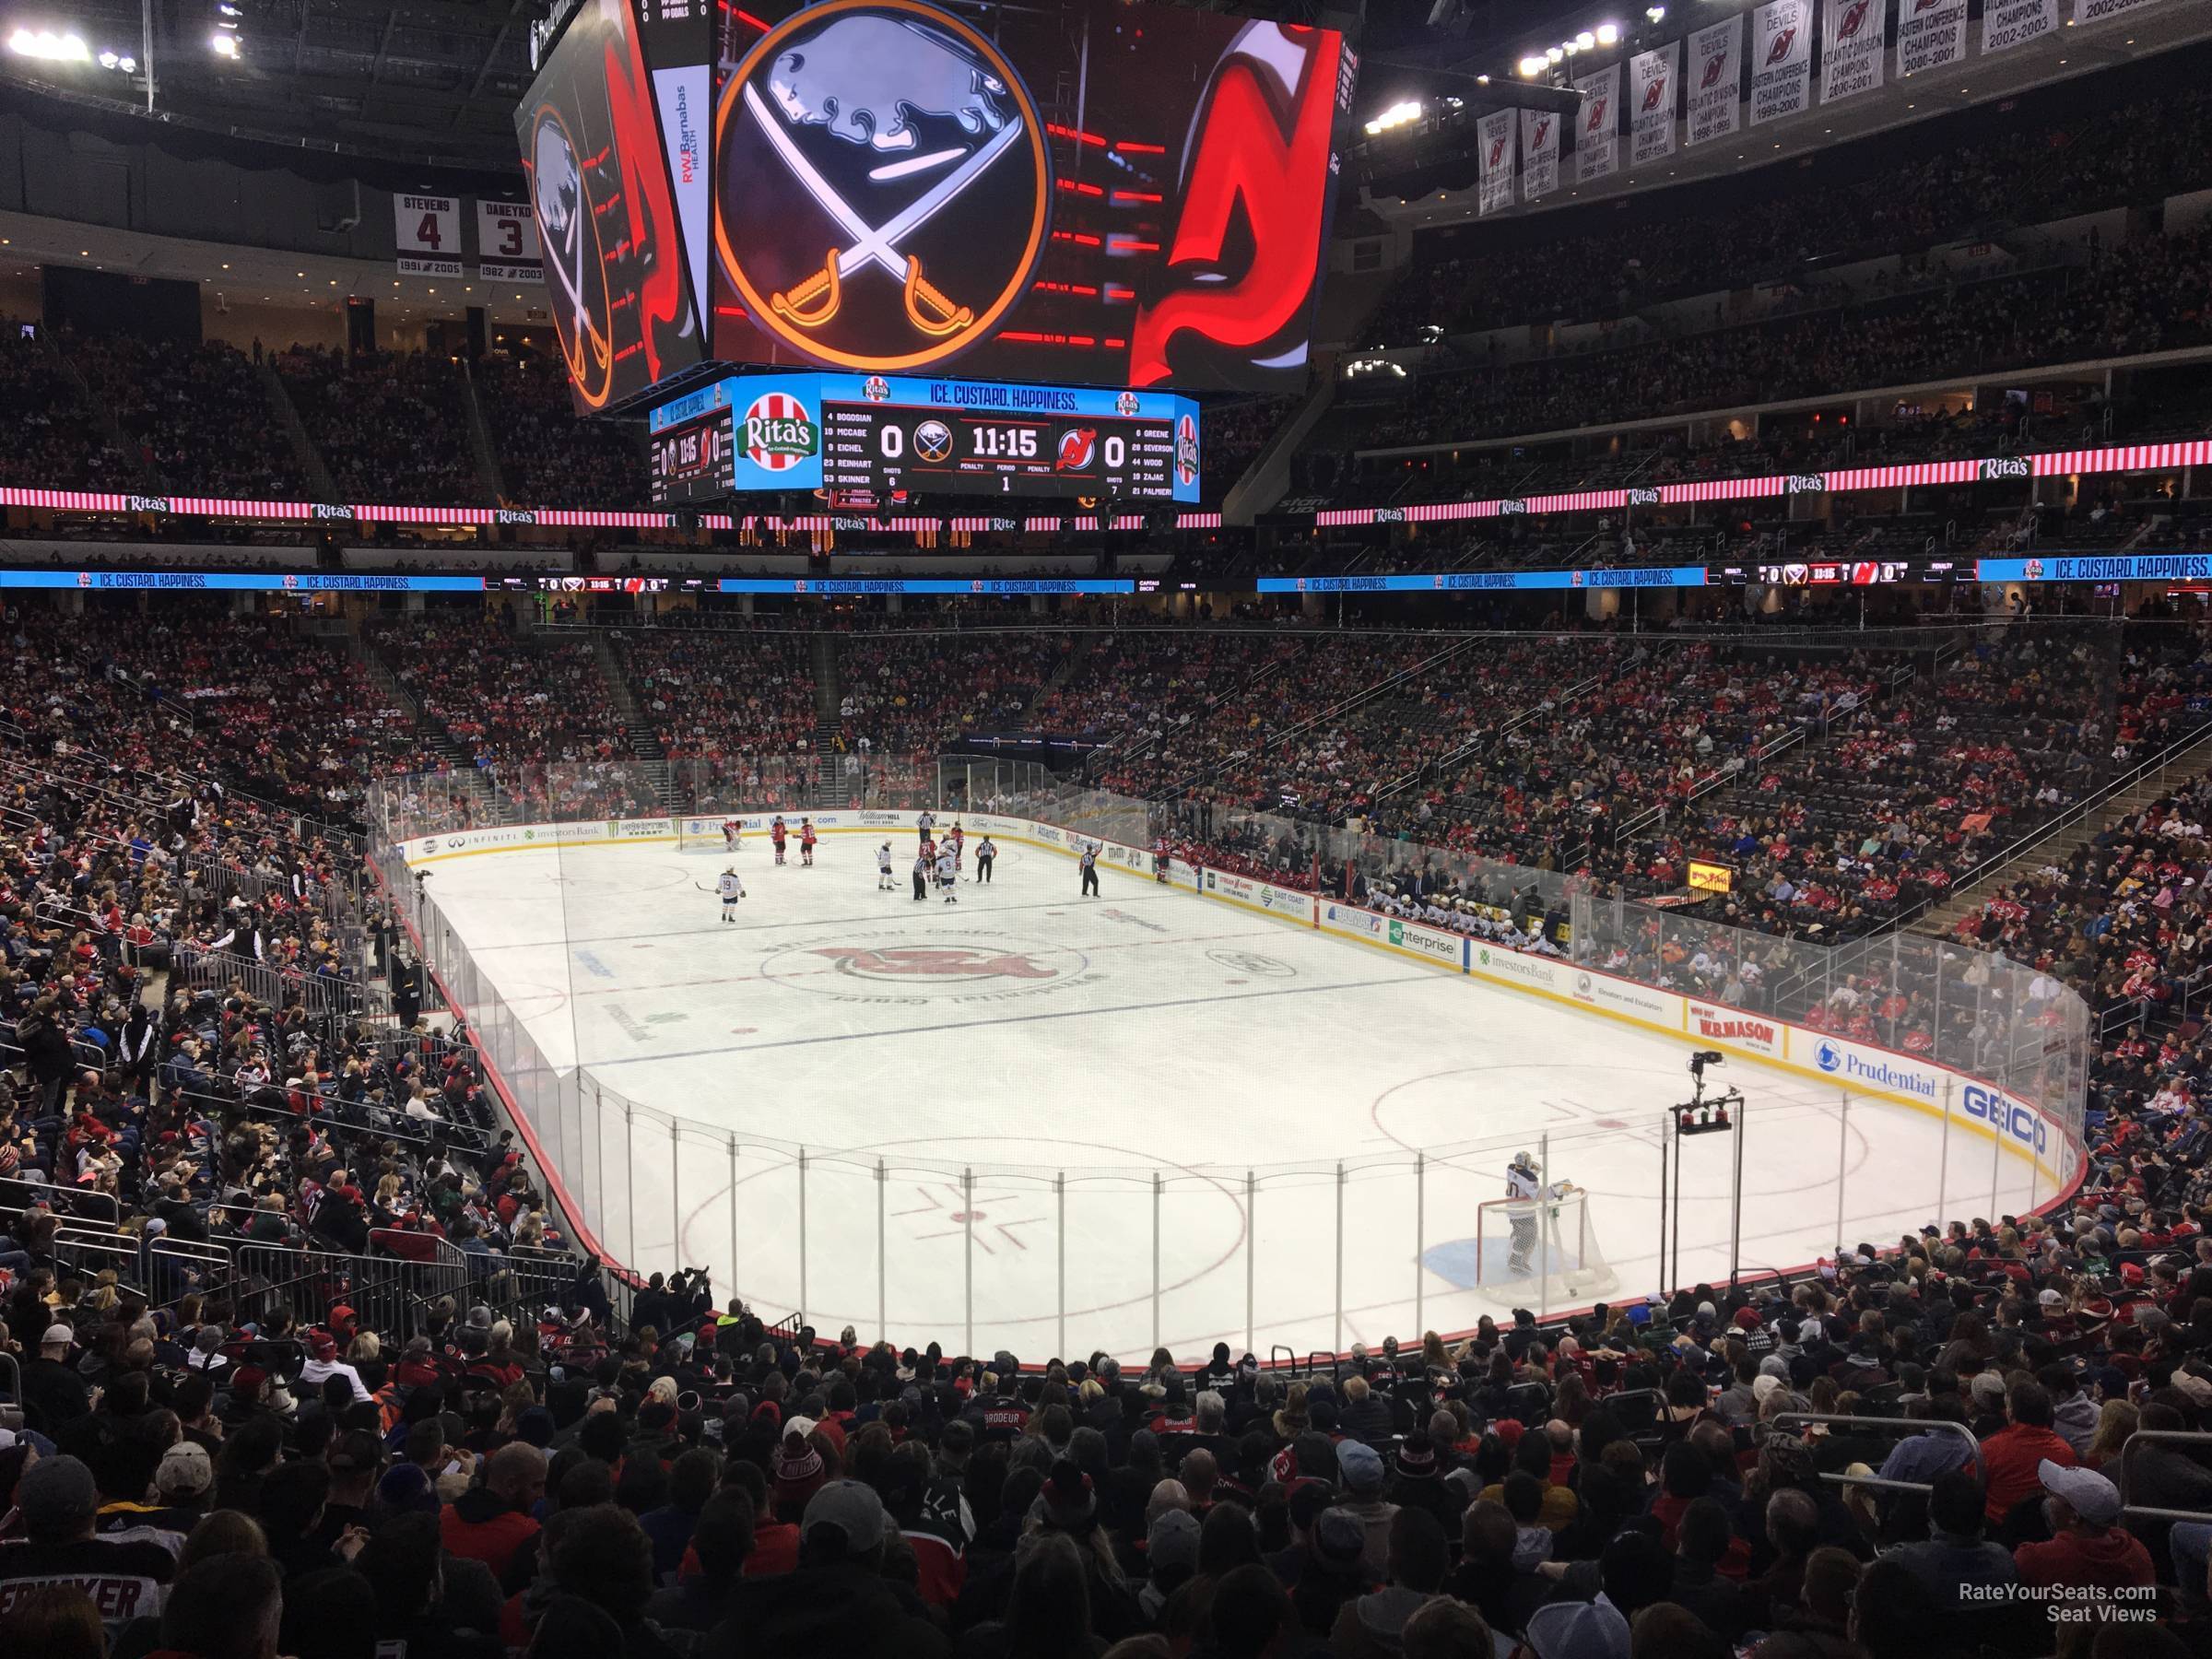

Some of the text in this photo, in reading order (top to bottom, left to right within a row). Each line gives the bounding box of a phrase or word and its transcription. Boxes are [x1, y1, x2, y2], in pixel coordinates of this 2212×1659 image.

[670, 6, 689, 18] GOALS
[1767, 10, 1798, 31] DEVILS
[1996, 1, 2043, 29] CHAMPIONS
[1899, 19, 1924, 40] EASTERN
[1924, 4, 1965, 31] CONFERENCE
[1904, 26, 1957, 56] CHAMPIONS
[1989, 17, 2049, 48] 2002-2003
[1700, 36, 1729, 56] DEVILS
[1822, 32, 1883, 66] ATLANTIC DIVISION
[1904, 47, 1956, 72] 2000-2001
[1641, 61, 1667, 80] DEVILS
[1752, 59, 1808, 89] EASTERN CONFERENCE
[1832, 57, 1869, 82] CHAMPIONS
[1713, 82, 1739, 103] DIVISION
[1757, 79, 1802, 105] CHAMPIONS
[1829, 74, 1873, 99] 2000-2001
[1696, 103, 1727, 126] CHAMPIONS
[1756, 97, 1800, 120] 1999-2000
[677, 85, 693, 184] RWJBarnabas
[1692, 119, 1731, 142] 1998-1999
[690, 129, 700, 171] HEALTH
[404, 196, 450, 212] STEVENS
[486, 203, 532, 218] DANEYKO
[417, 213, 441, 251] 4
[498, 218, 524, 256] 3
[400, 262, 460, 274] 1991 2005
[482, 266, 543, 279] 1982 2003
[930, 383, 1079, 411] ICE. CUSTARD. HAPPINESS.
[837, 413, 872, 422] BOGOSIAN
[747, 417, 811, 450] Rita's
[837, 428, 867, 437] MCCABE
[881, 425, 903, 458] 0
[1144, 429, 1170, 439] GREENE
[679, 434, 697, 465] 11:15
[837, 443, 864, 453] EICHEL
[973, 427, 1037, 457] 11:15
[1144, 444, 1174, 453] SEVERSON
[1178, 434, 1197, 465] Rita's
[1105, 436, 1124, 467] 0
[838, 459, 873, 468] REINHART
[960, 463, 1051, 473] PENALTY PERIOD PENALTY
[1143, 458, 1163, 466] WOOD
[1985, 457, 2028, 479] Rita's
[824, 475, 870, 484] 53 SKINNER
[888, 477, 896, 487] 6
[1003, 476, 1010, 492] 1
[1143, 473, 1164, 481] ZAJAC
[1789, 474, 1822, 494] Rita's
[1112, 486, 1118, 495] 7
[1143, 488, 1172, 496] PALMIERI
[1630, 488, 1659, 506] Rita's
[130, 495, 168, 512] Rita's
[316, 503, 352, 519] Rita's
[1501, 499, 1524, 515] Rita's
[498, 509, 533, 524] Rita's
[835, 517, 865, 530] Rita's
[1377, 508, 1402, 523] Rita's
[1814, 568, 1835, 580] 11:15
[1885, 565, 1894, 580] 0
[2055, 558, 2210, 579] ICE. CUSTARD. HAPPINESS.
[100, 573, 207, 587] ICE. CUSTARD. HAPPINESS.
[307, 576, 411, 589] ICE. CUSTARD. HAPPINESS.
[814, 582, 906, 592] ICE. CUSTARD. HAPPINESS.
[991, 581, 1077, 592] ICE. CUSTARD. HAPPINESS.
[1589, 570, 1675, 586] ICE. CUSTARD. HAPPINESS.
[468, 833, 517, 844] INFINITI
[1274, 889, 1305, 905] EAST COAST
[1389, 927, 1454, 954] enterprise
[1598, 987, 1664, 1013] Elevators and Escalators
[1847, 1053, 1936, 1098] Prudential
[1963, 1085, 2046, 1155] GEICO
[984, 1413, 1019, 1424] BRODEUR
